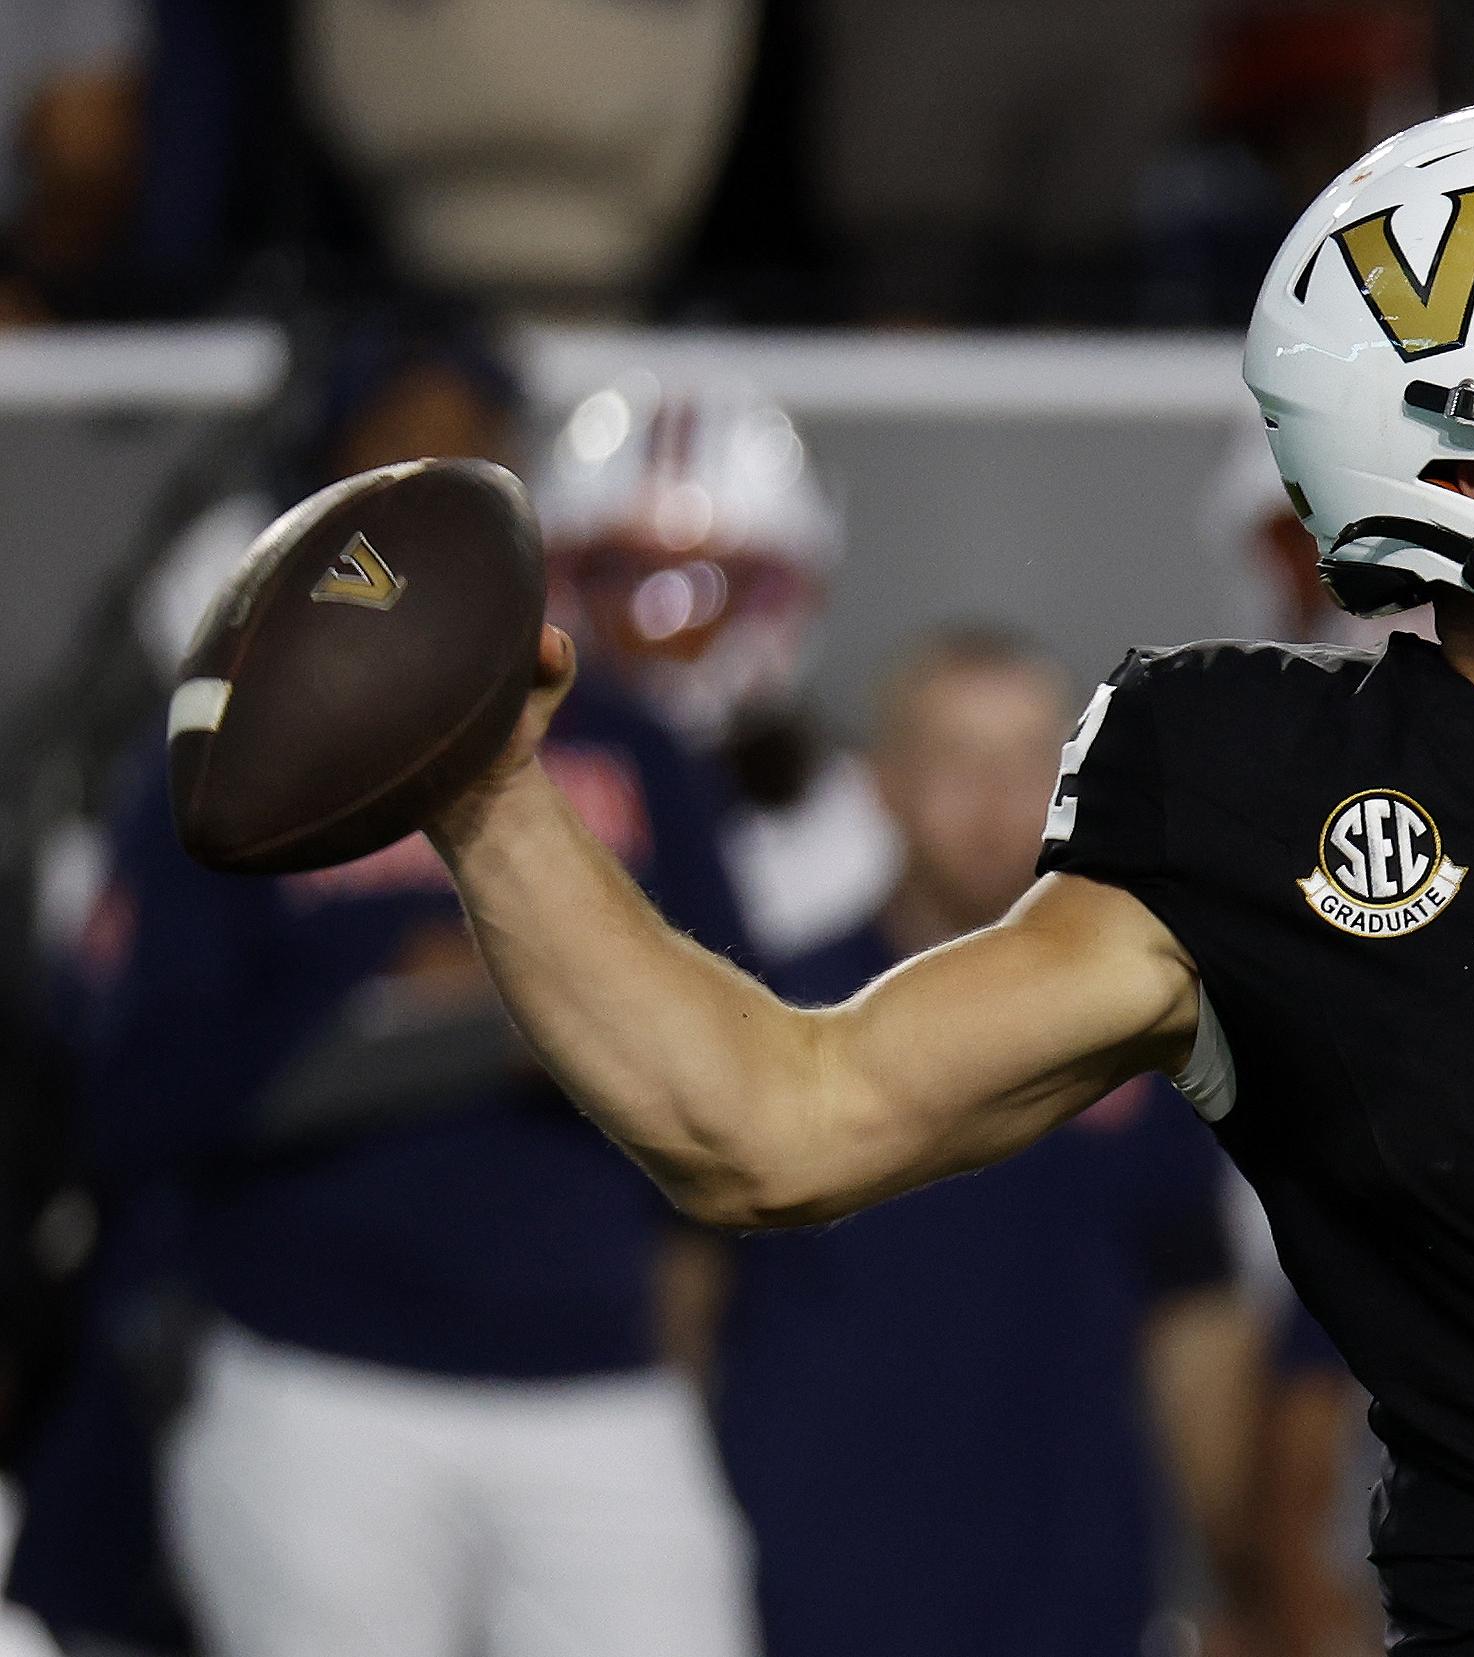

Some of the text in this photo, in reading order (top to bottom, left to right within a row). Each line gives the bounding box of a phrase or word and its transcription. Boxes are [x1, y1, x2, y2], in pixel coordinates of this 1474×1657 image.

[311, 531, 408, 611] V
[1330, 798, 1430, 898] SEC
[1320, 886, 1447, 933] GRADUATE
